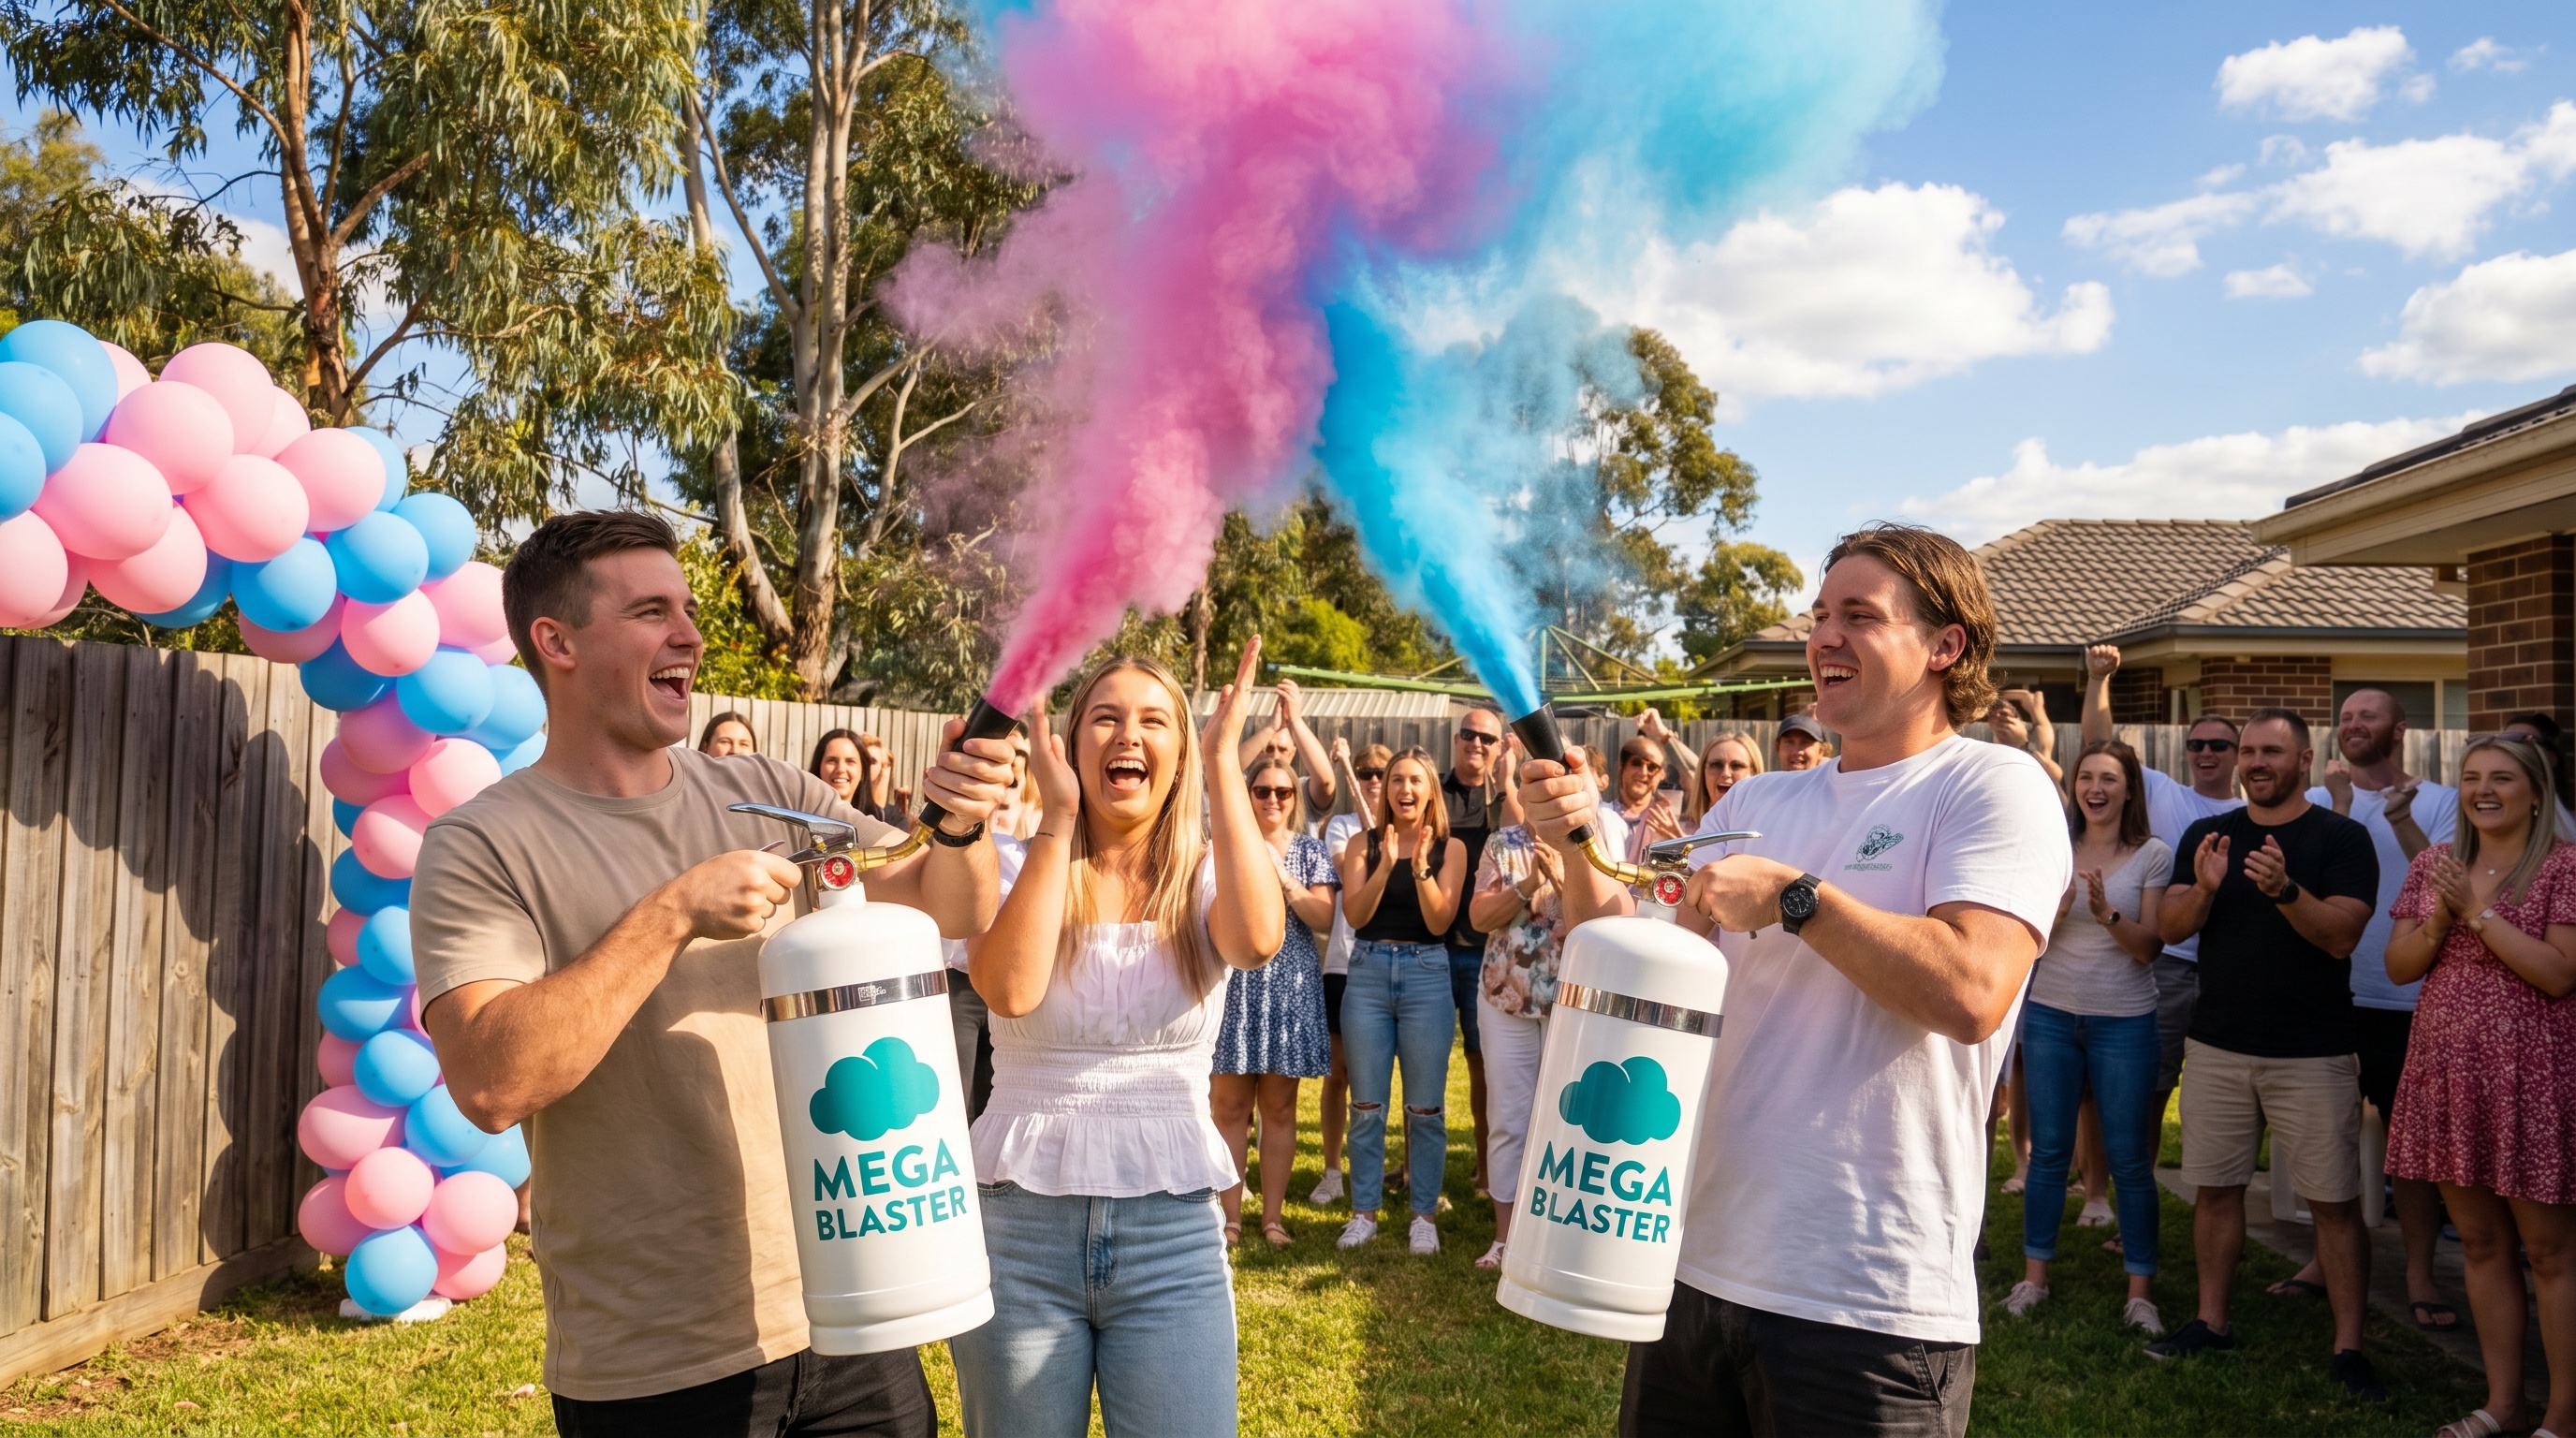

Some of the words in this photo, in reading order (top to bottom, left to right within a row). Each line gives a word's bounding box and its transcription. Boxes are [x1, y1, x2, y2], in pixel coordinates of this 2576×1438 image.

[813, 1139, 960, 1202] MEGA
[1537, 1142, 1672, 1207] MEGA
[815, 1185, 967, 1240] BLASTER
[1530, 1186, 1672, 1243] BLASTER
